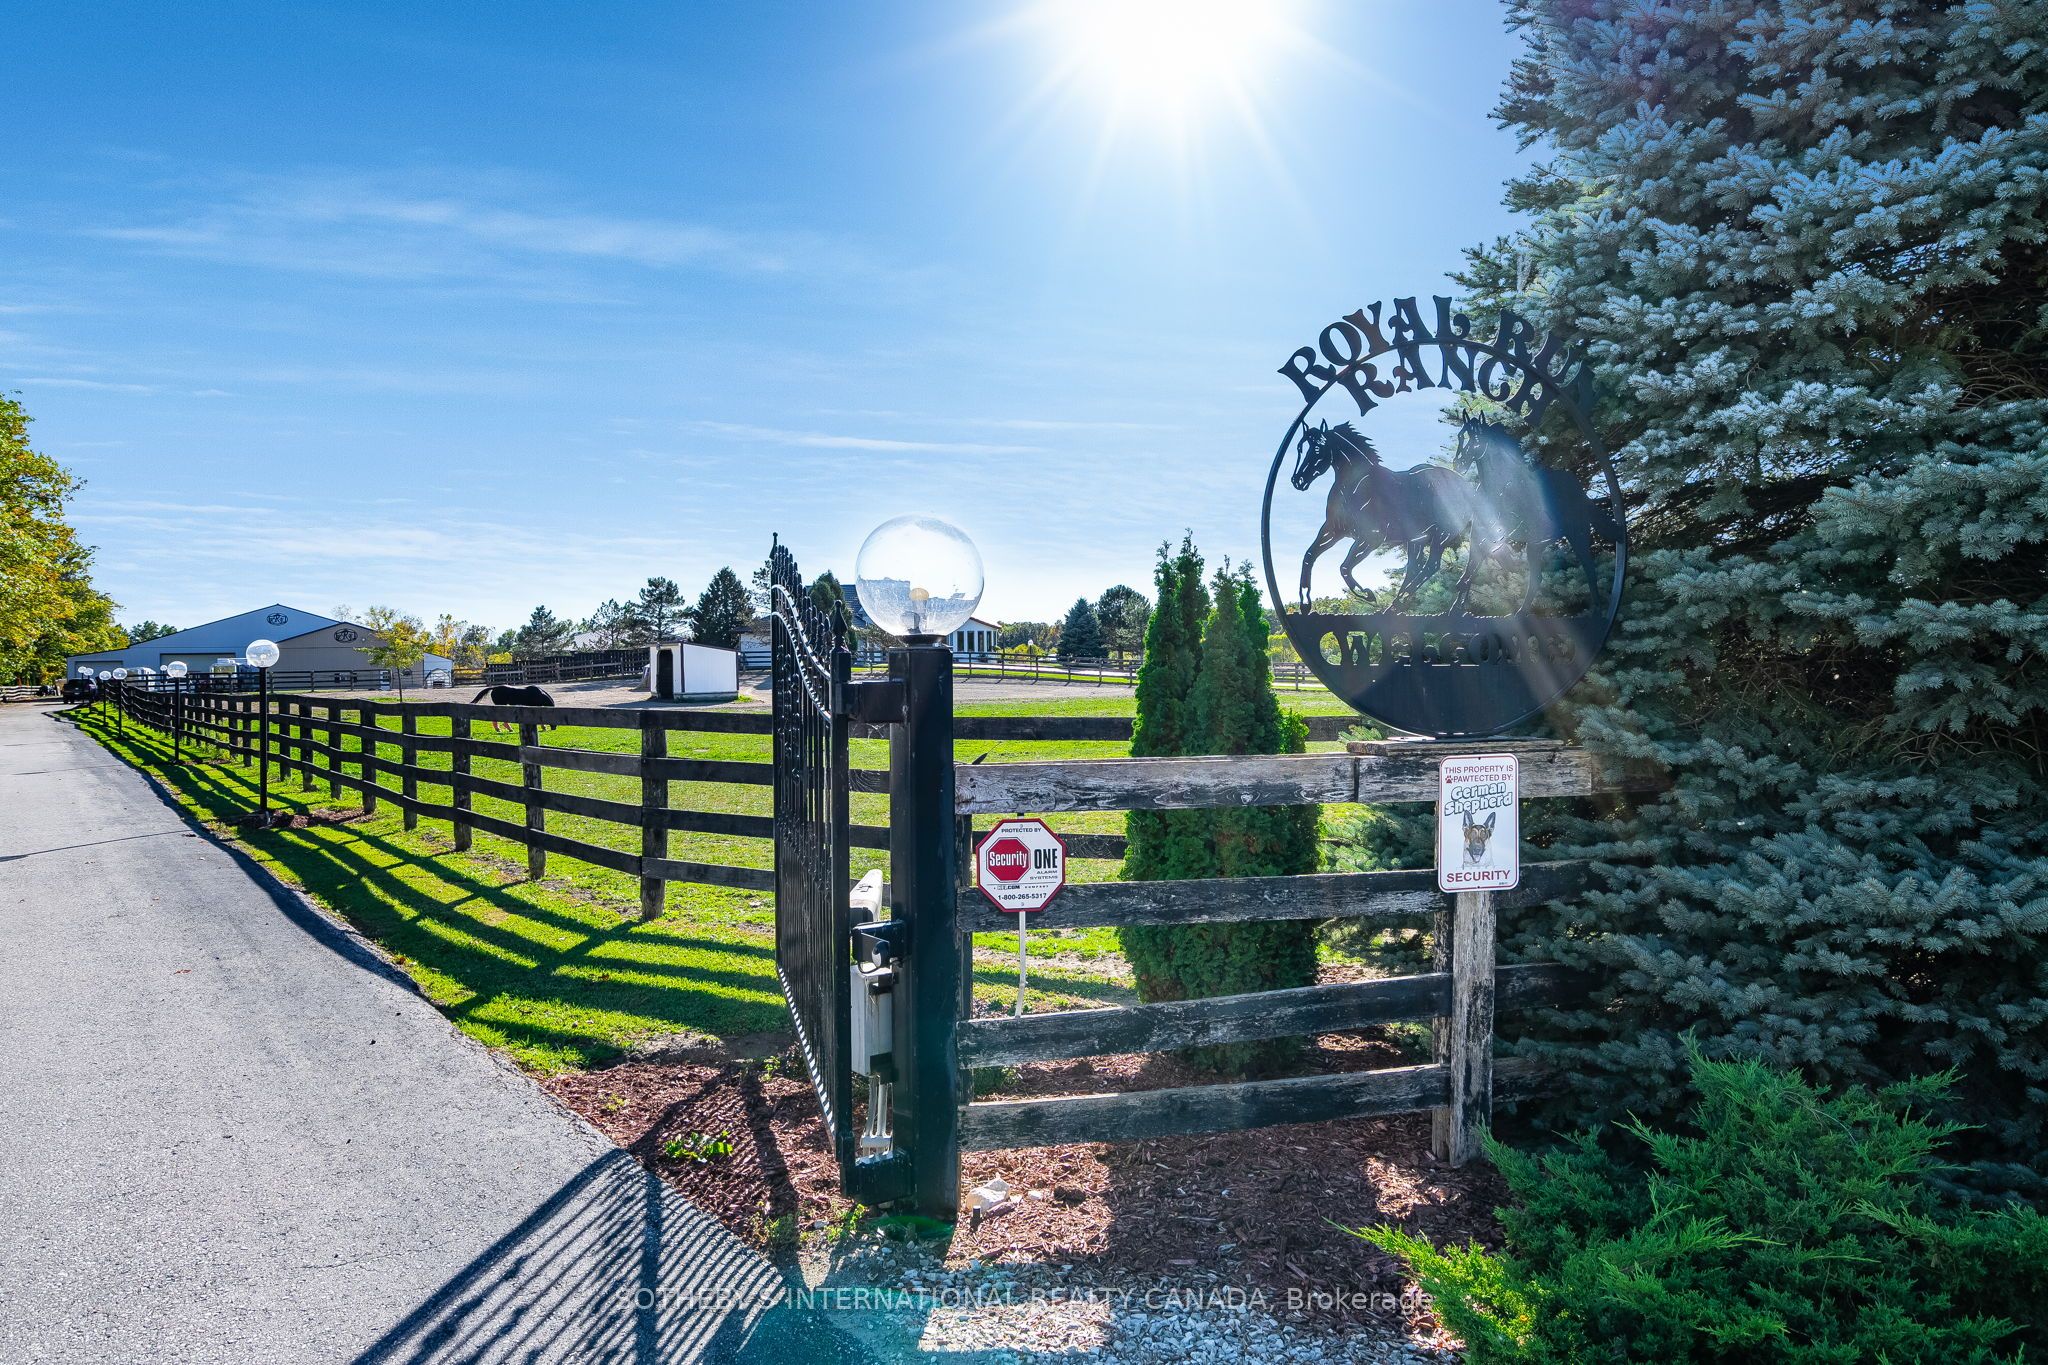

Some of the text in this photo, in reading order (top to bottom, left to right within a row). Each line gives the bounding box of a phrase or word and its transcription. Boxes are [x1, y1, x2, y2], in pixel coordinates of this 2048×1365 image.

[1277, 294, 1471, 403] ROYAL
[1337, 342, 1559, 429] RANCH
[1445, 764, 1514, 774] THIS PROPERTY IS
[1454, 773, 1514, 783] PAWTECTED BY:
[1451, 781, 1506, 801] German
[1444, 791, 1513, 816] Shepherd
[989, 848, 1058, 869] Security ONE
[1446, 869, 1511, 883] SECURITY
